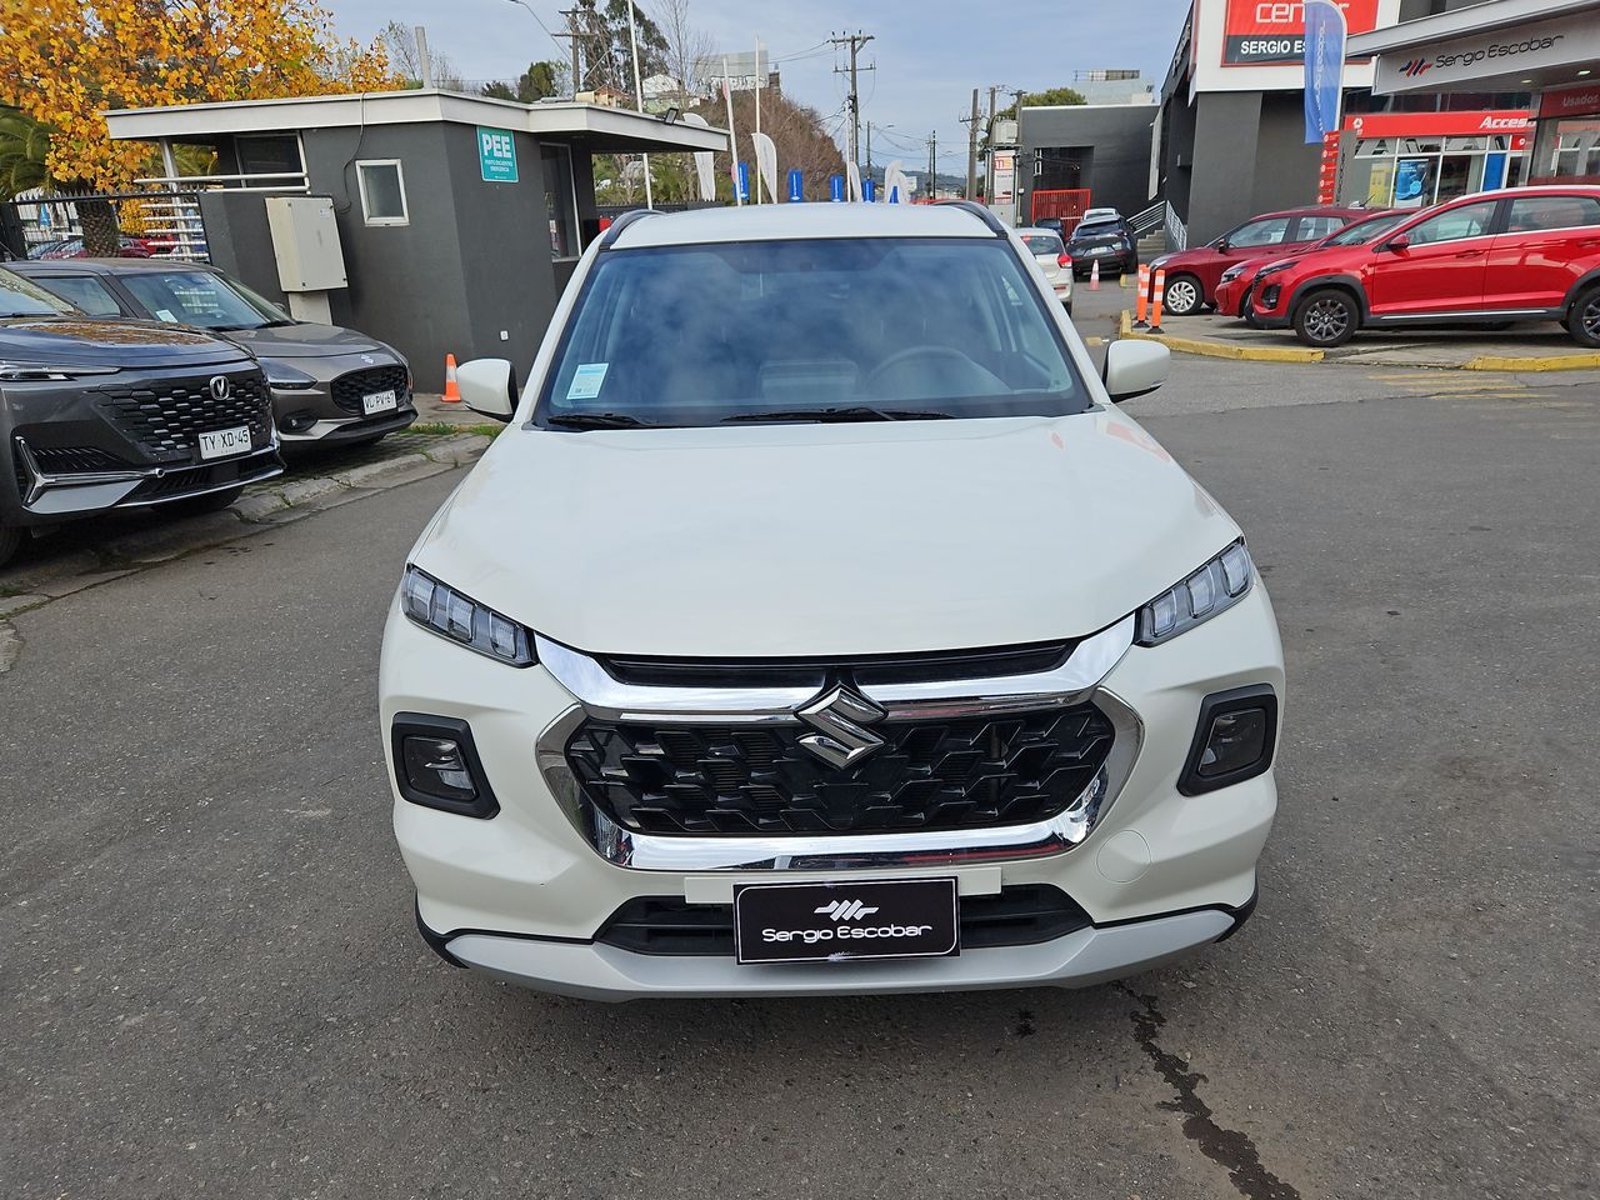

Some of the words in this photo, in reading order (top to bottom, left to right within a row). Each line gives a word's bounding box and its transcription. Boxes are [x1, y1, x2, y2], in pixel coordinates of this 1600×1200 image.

[1240, 40, 1291, 55] SERGIO
[1488, 35, 1564, 59] Escobar
[482, 133, 512, 158] PEE
[762, 928, 833, 944] Sergio
[837, 923, 932, 939] Escobar
